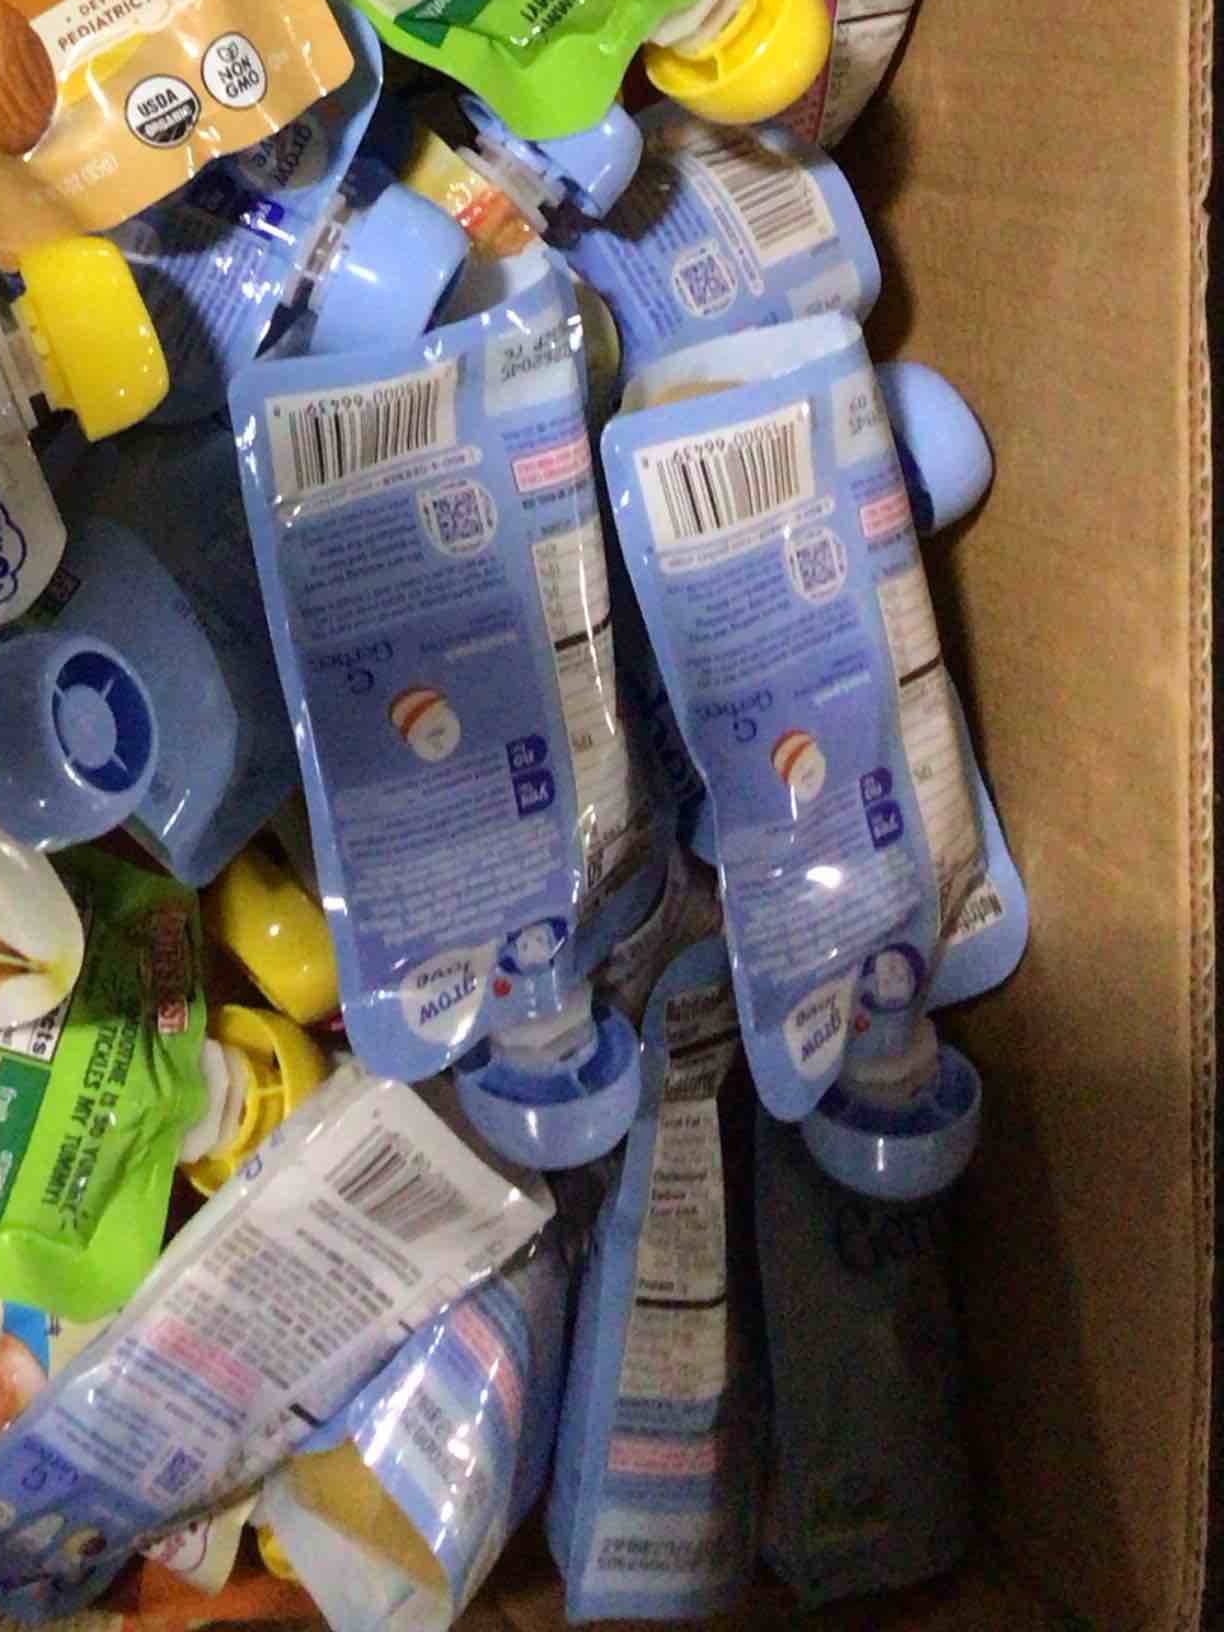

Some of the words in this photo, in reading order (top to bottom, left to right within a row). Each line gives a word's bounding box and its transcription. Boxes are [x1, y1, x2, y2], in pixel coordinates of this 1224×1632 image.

[216, 55, 253, 84] NON
[223, 69, 261, 99] GMO
[135, 86, 180, 119] USDA
[413, 976, 481, 1025] grow
[80, 1023, 118, 1091] TICKLES
[68, 1094, 94, 1126] MY
[40, 1132, 81, 1208] TUMMY!
